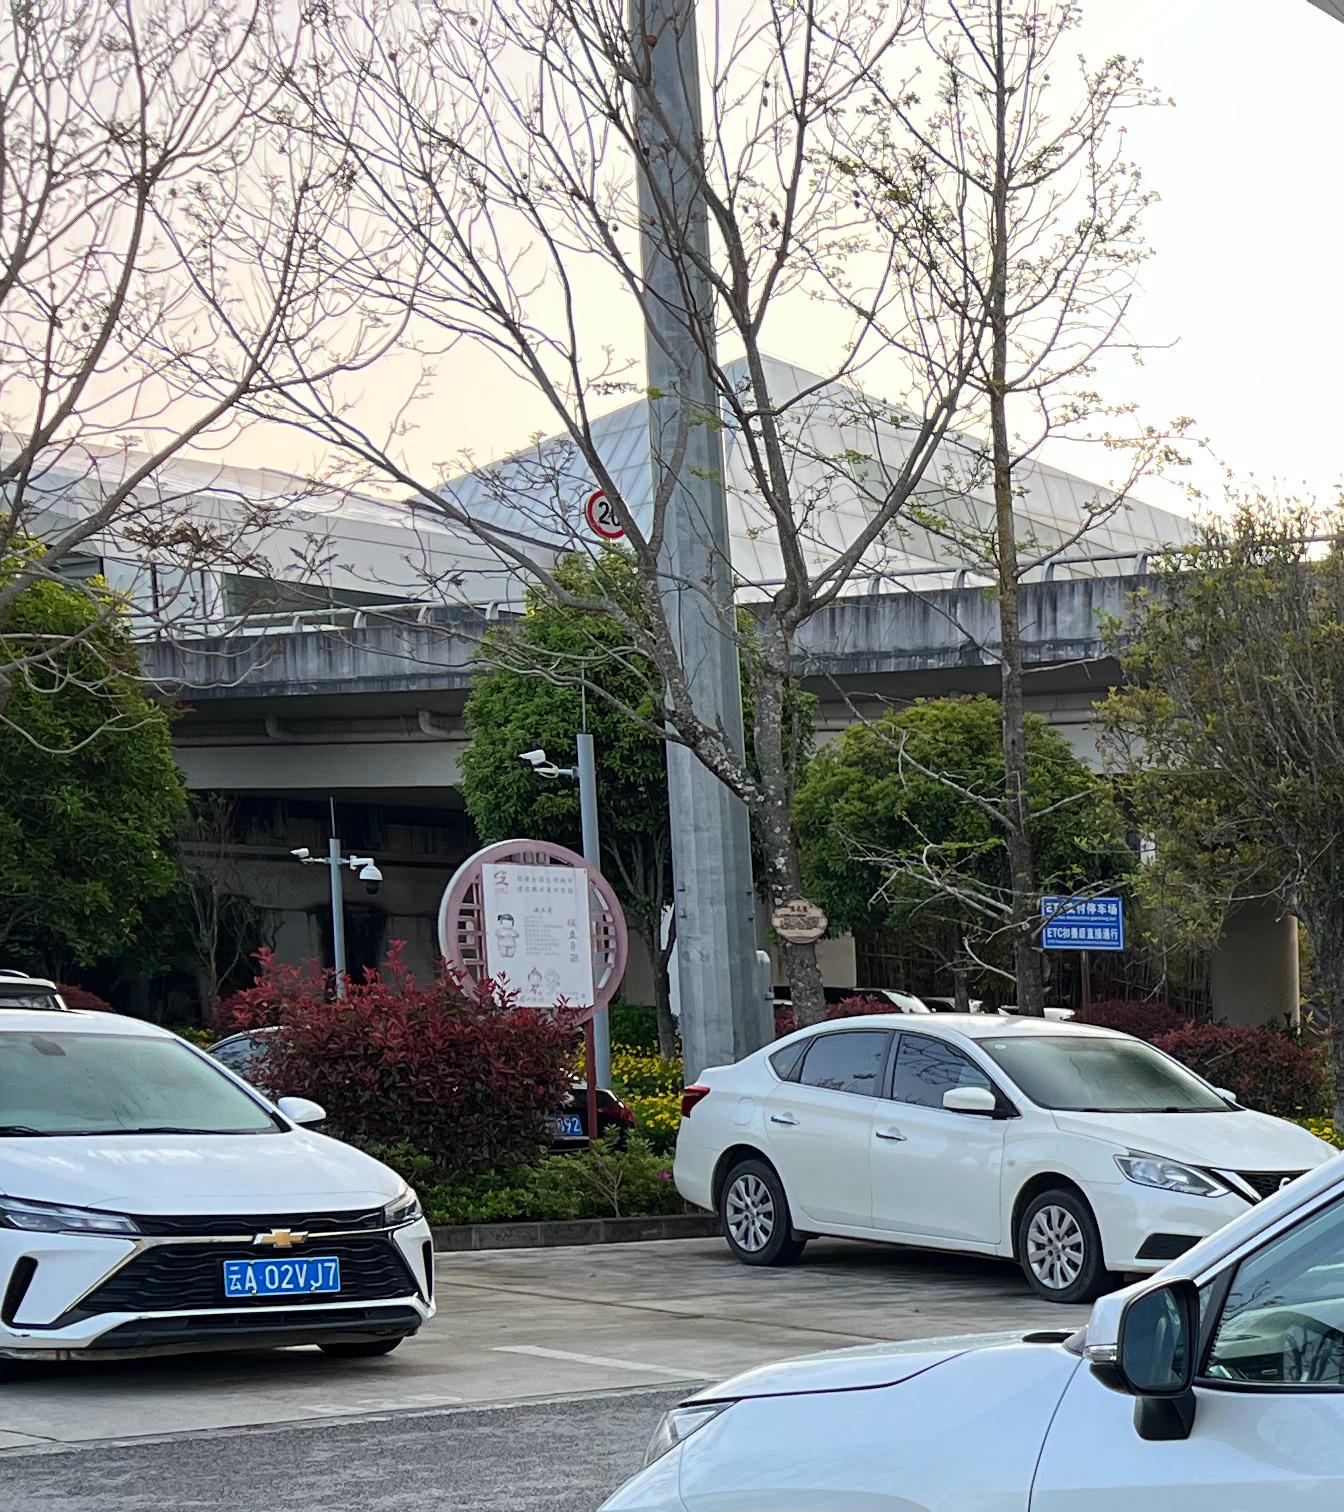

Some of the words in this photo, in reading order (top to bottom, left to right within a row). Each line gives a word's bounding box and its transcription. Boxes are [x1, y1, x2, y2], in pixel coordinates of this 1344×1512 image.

[1045, 902, 1118, 916] ET支付停车场
